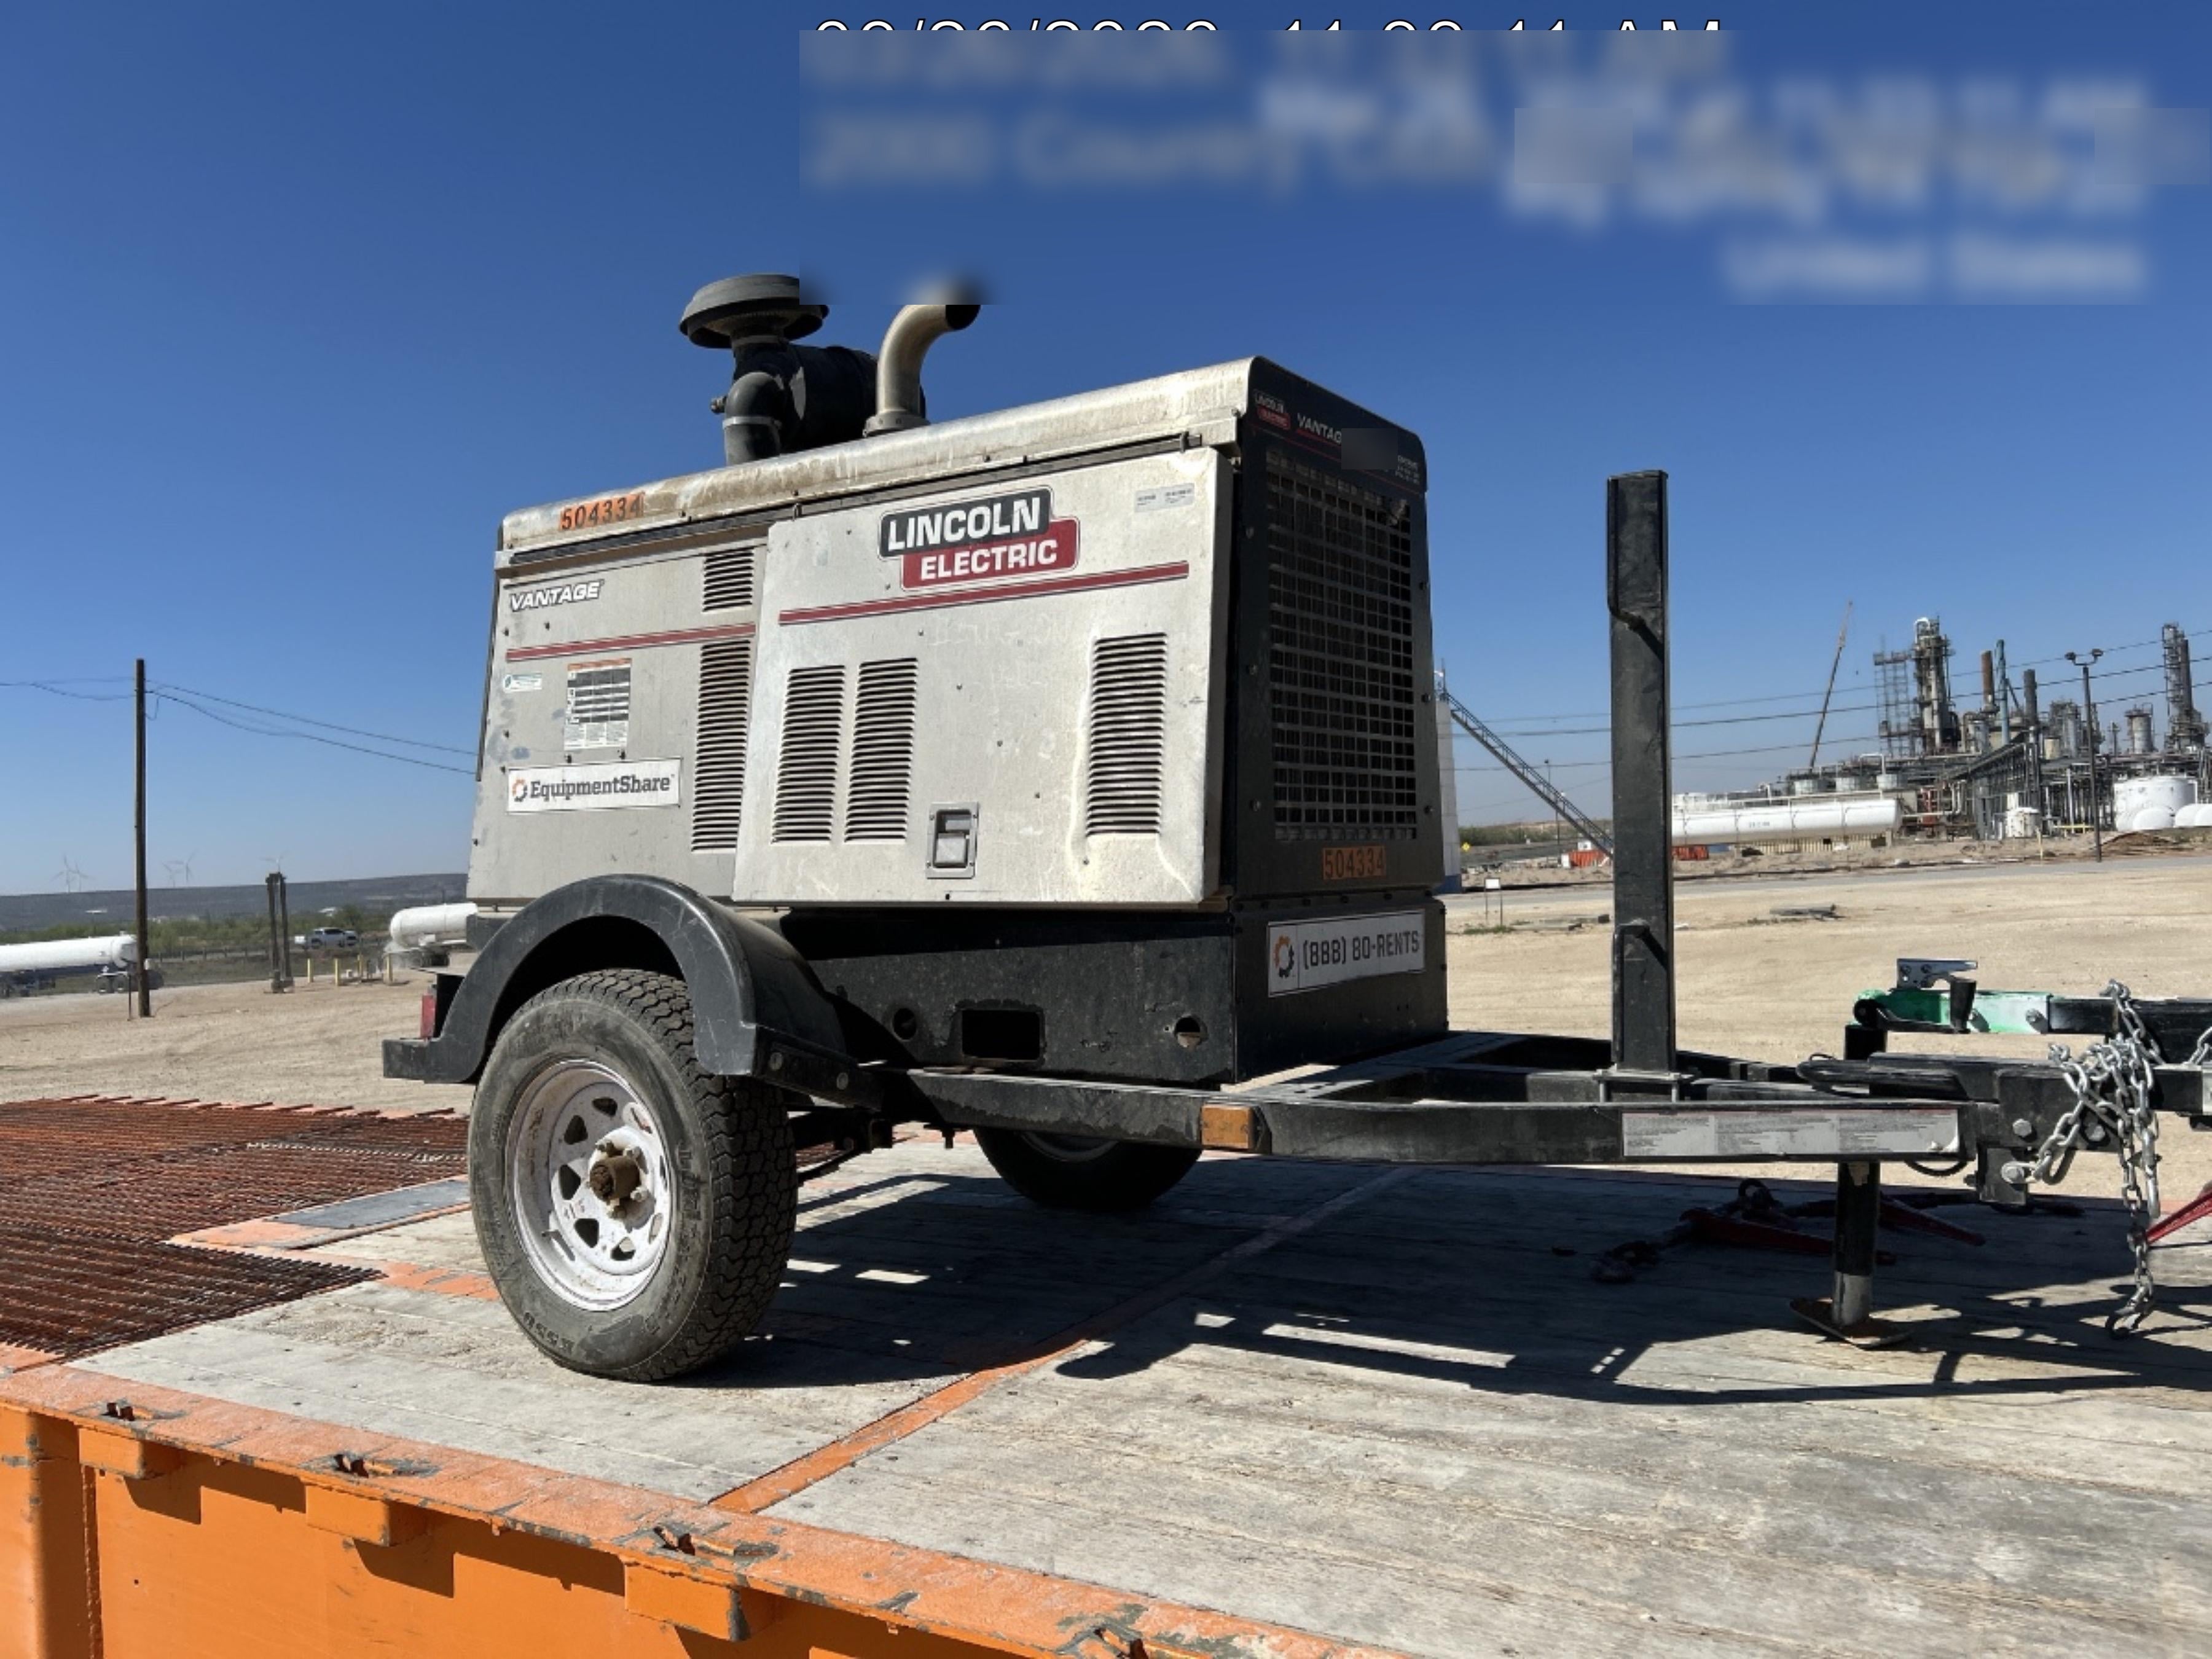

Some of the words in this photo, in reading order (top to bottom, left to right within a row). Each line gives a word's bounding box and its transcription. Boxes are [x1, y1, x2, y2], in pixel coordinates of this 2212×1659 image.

[1296, 412, 1342, 444] VANTAG
[560, 492, 644, 530] 504334
[887, 496, 1040, 551] LINCOLN
[920, 538, 1058, 581] ELECTRIC
[510, 581, 602, 612] VANTAGE
[530, 774, 670, 801] EquipmentShare
[1324, 847, 1384, 879] 504334
